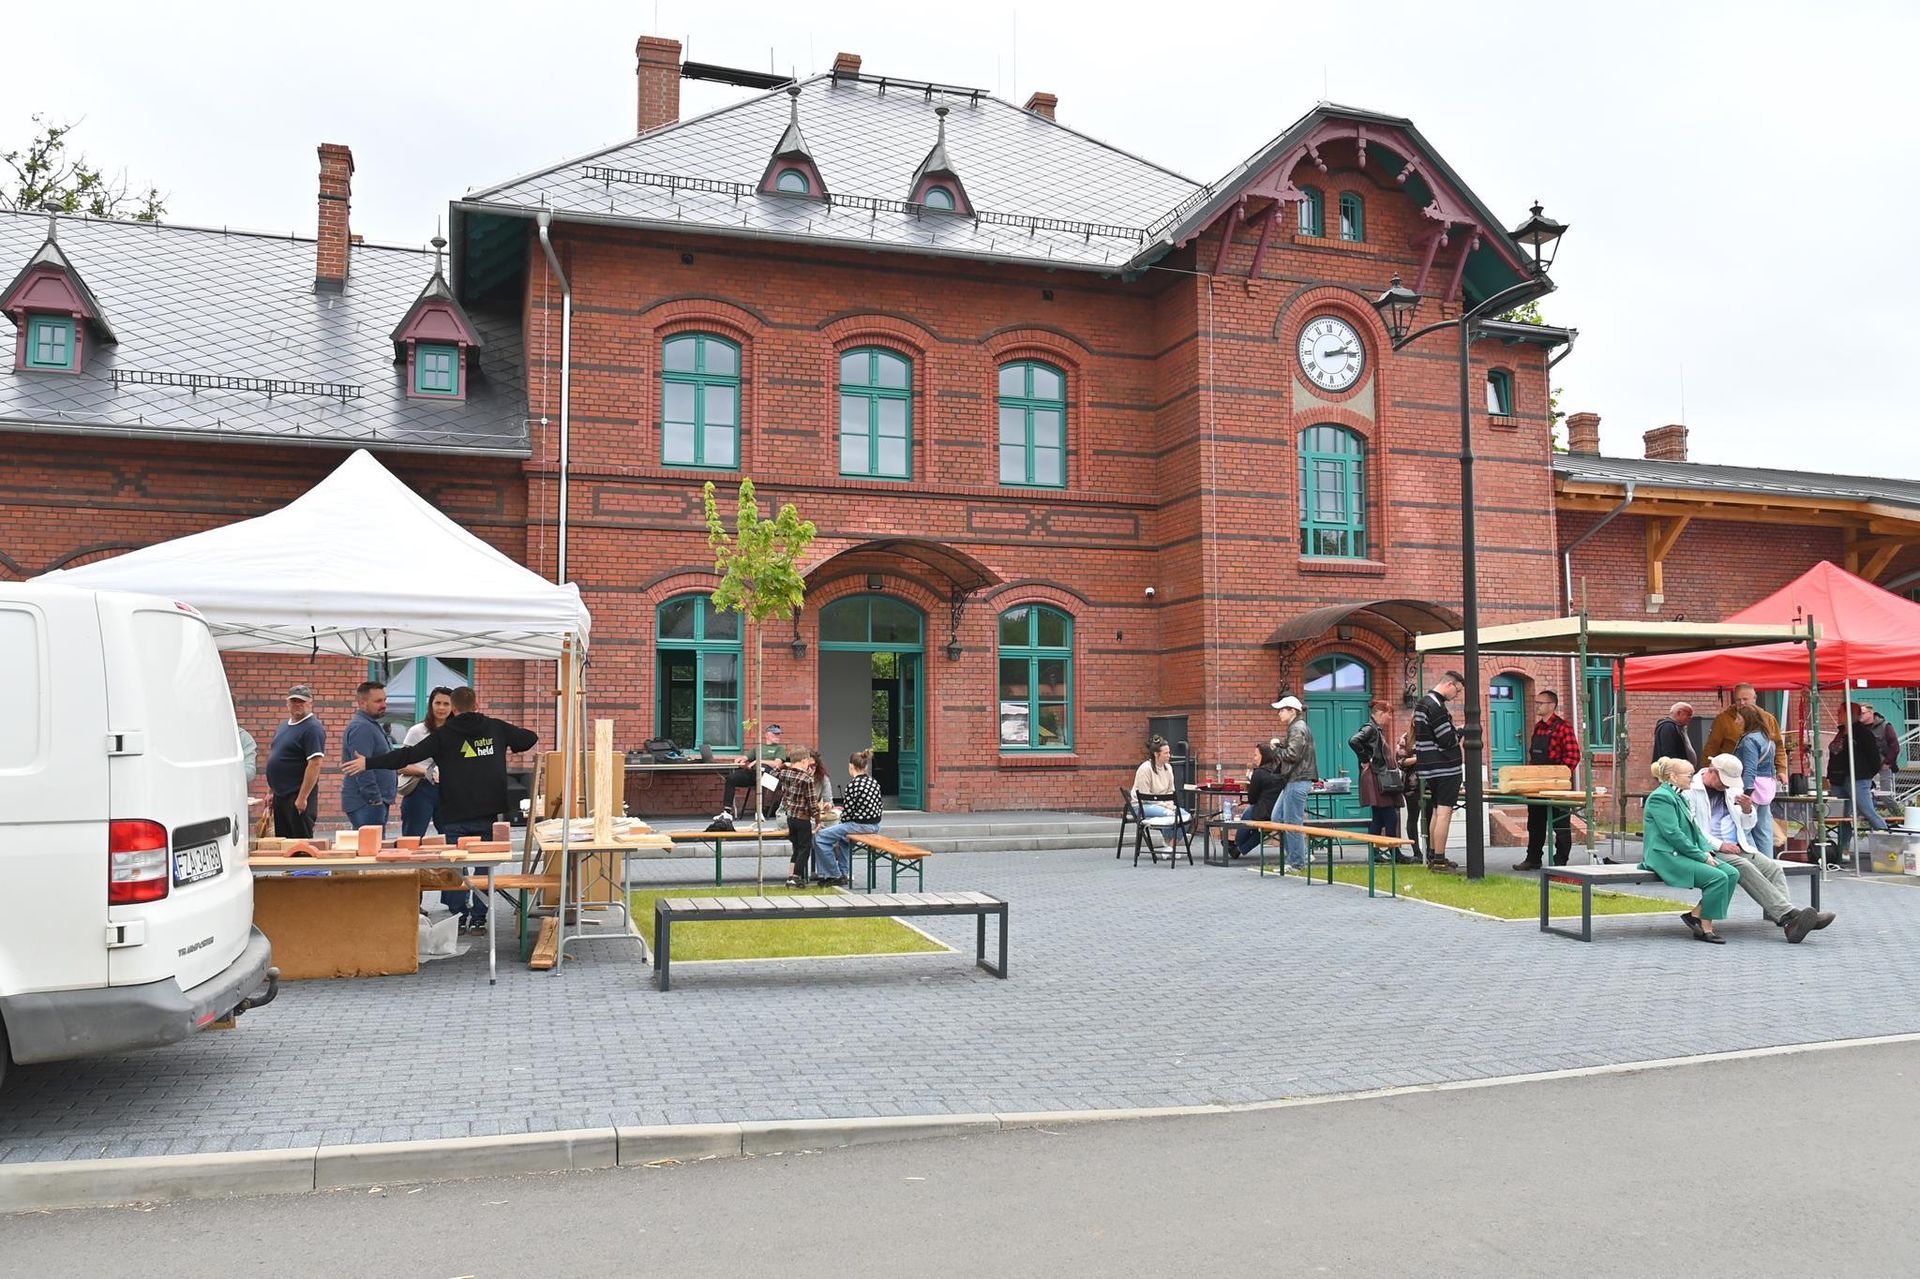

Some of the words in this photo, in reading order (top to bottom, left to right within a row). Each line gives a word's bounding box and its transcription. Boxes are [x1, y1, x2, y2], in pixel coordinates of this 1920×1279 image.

[474, 737, 493, 747] natur
[477, 745, 494, 756] held
[177, 851, 197, 877] FZA
